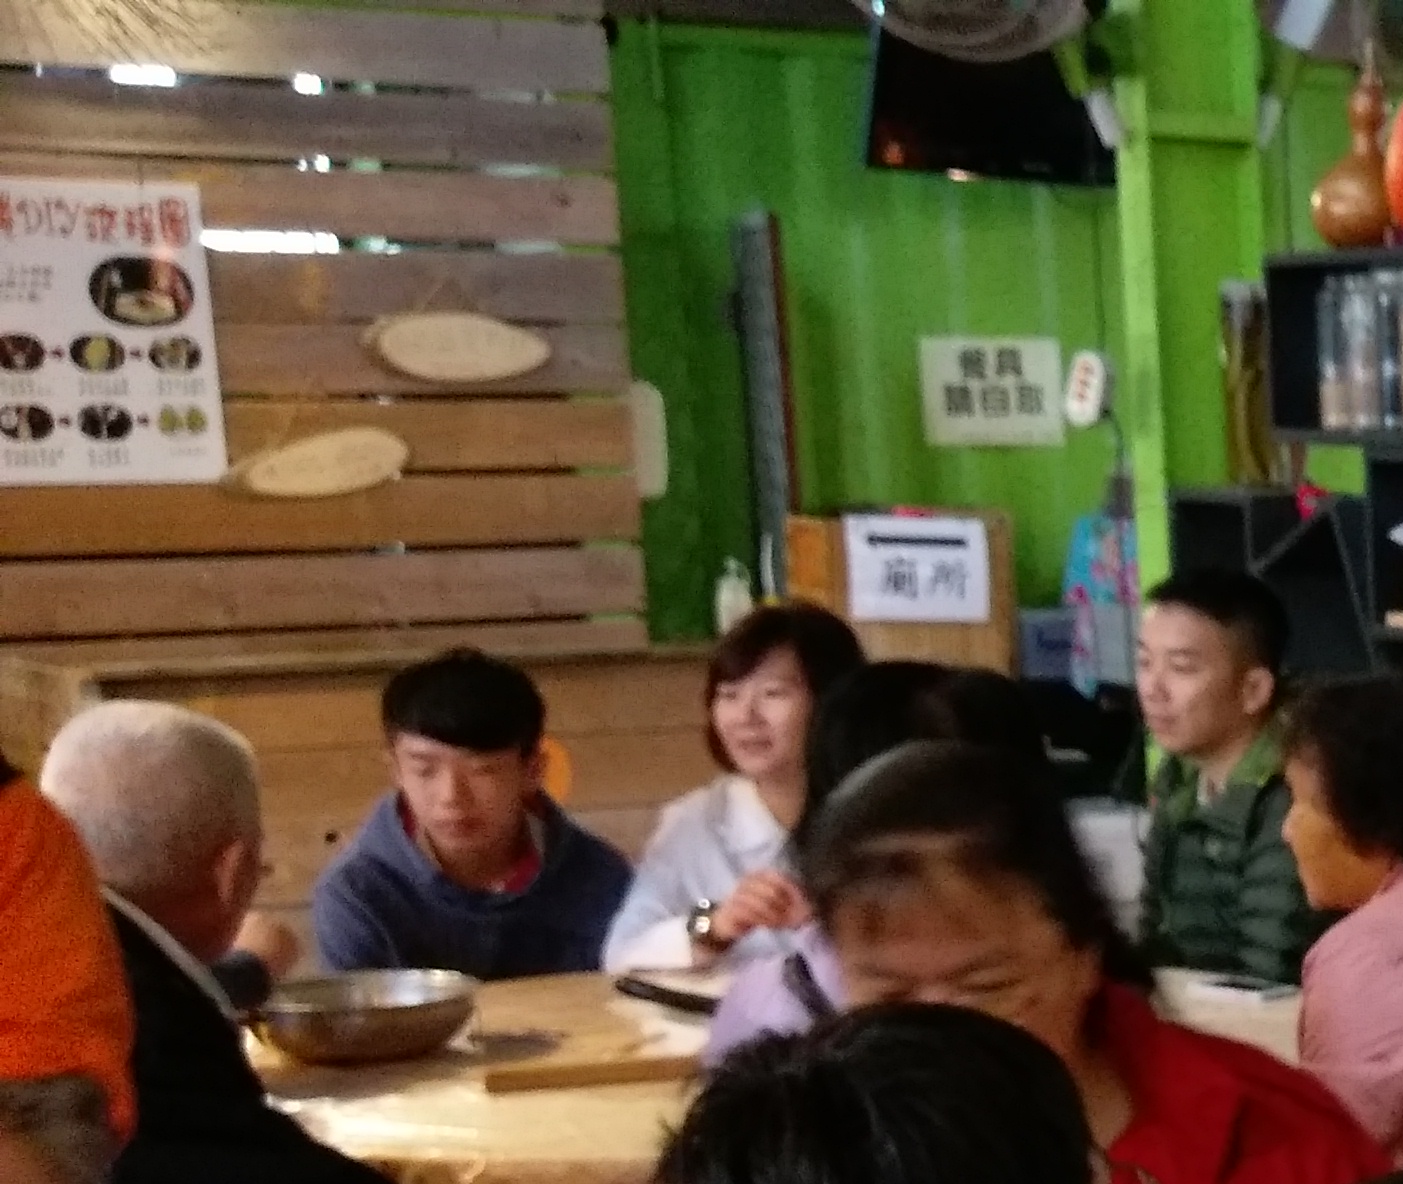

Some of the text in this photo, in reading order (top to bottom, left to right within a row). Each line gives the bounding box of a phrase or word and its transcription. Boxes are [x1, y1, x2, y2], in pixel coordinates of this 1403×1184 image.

[960, 346, 1023, 379] 餐具
[944, 383, 1045, 417] 請自取
